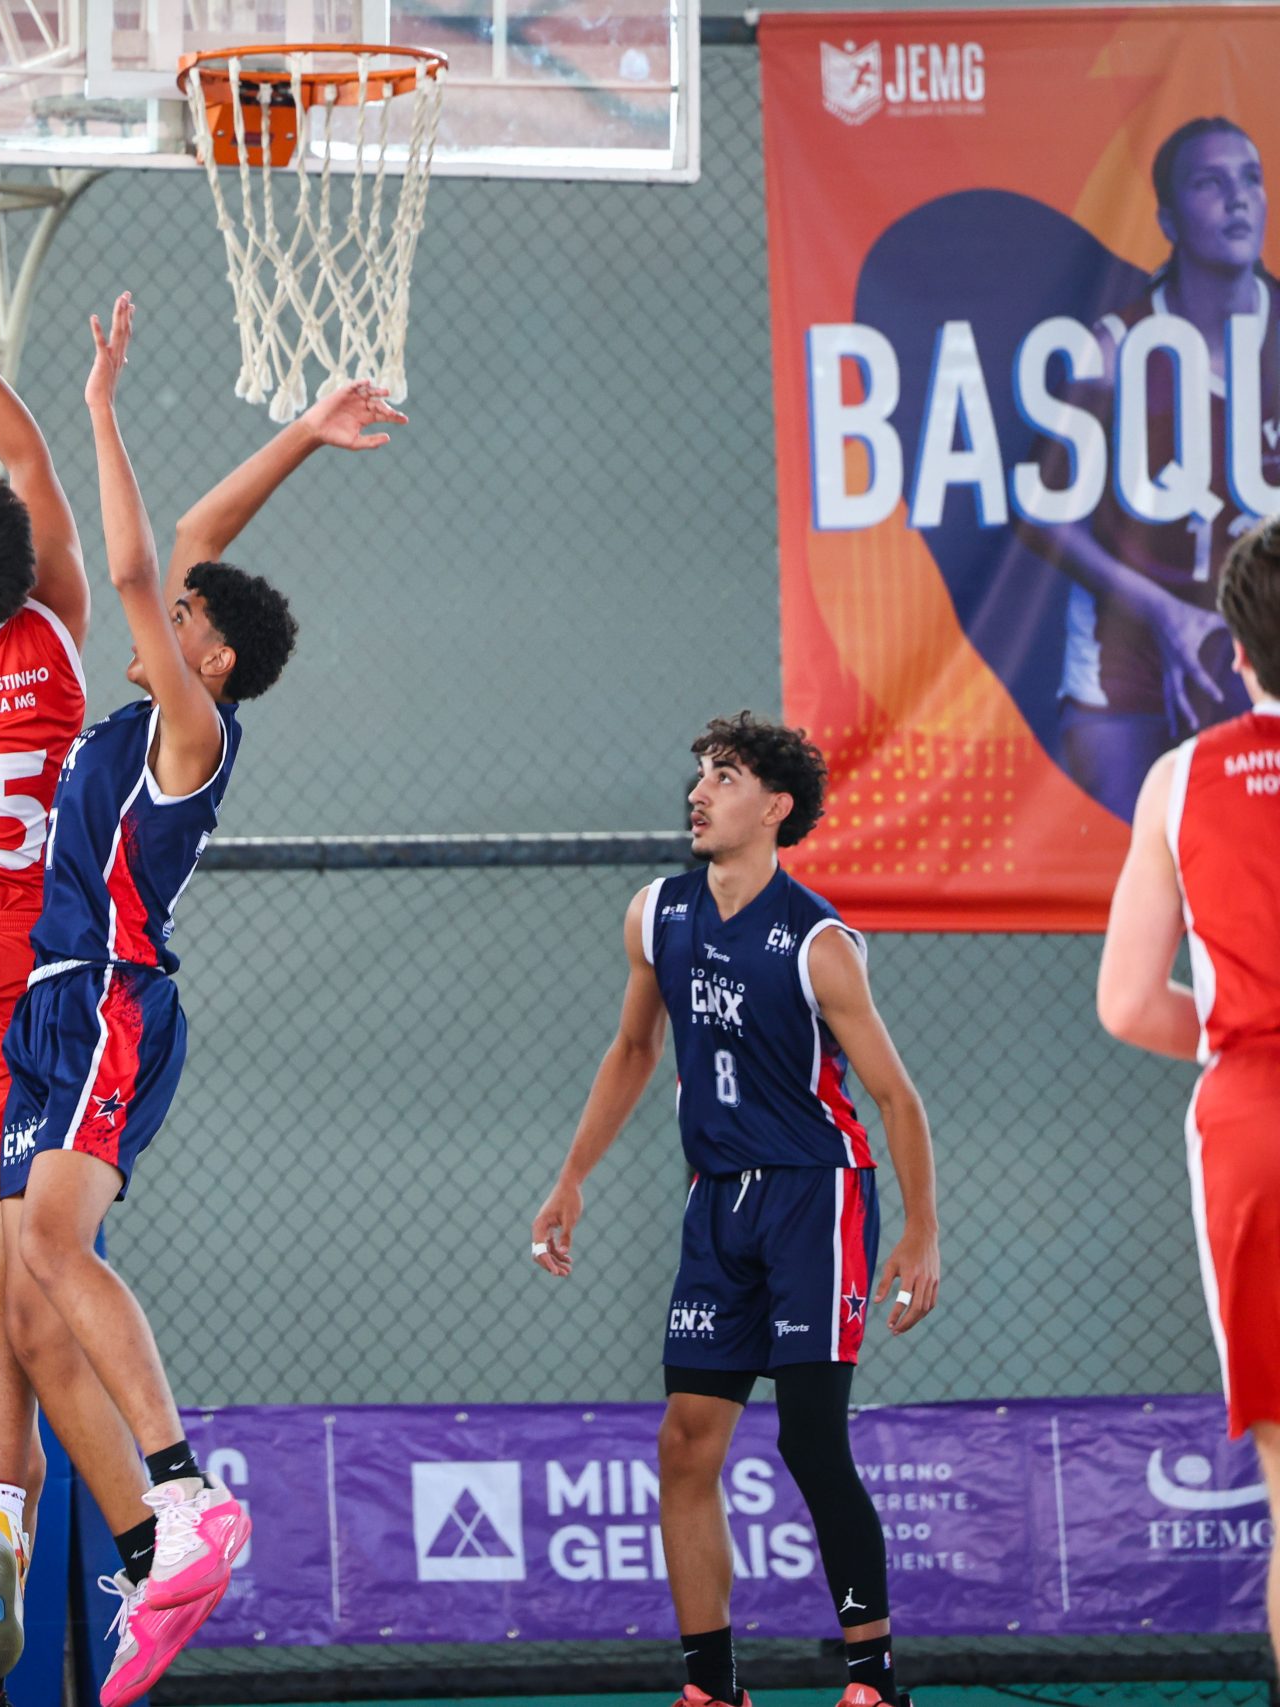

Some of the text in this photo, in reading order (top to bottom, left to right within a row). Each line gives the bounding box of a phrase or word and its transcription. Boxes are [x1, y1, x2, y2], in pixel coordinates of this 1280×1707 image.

[885, 42, 986, 103] JEMG
[14, 692, 36, 708] MG
[1246, 774, 1280, 796] NO
[691, 979, 744, 1027] CNX
[714, 1049, 741, 1108] 8
[670, 1308, 716, 1332] CNX
[855, 1462, 952, 1481] VERNO
[546, 1457, 776, 1516] MINS
[871, 1491, 979, 1512] ERENTE.
